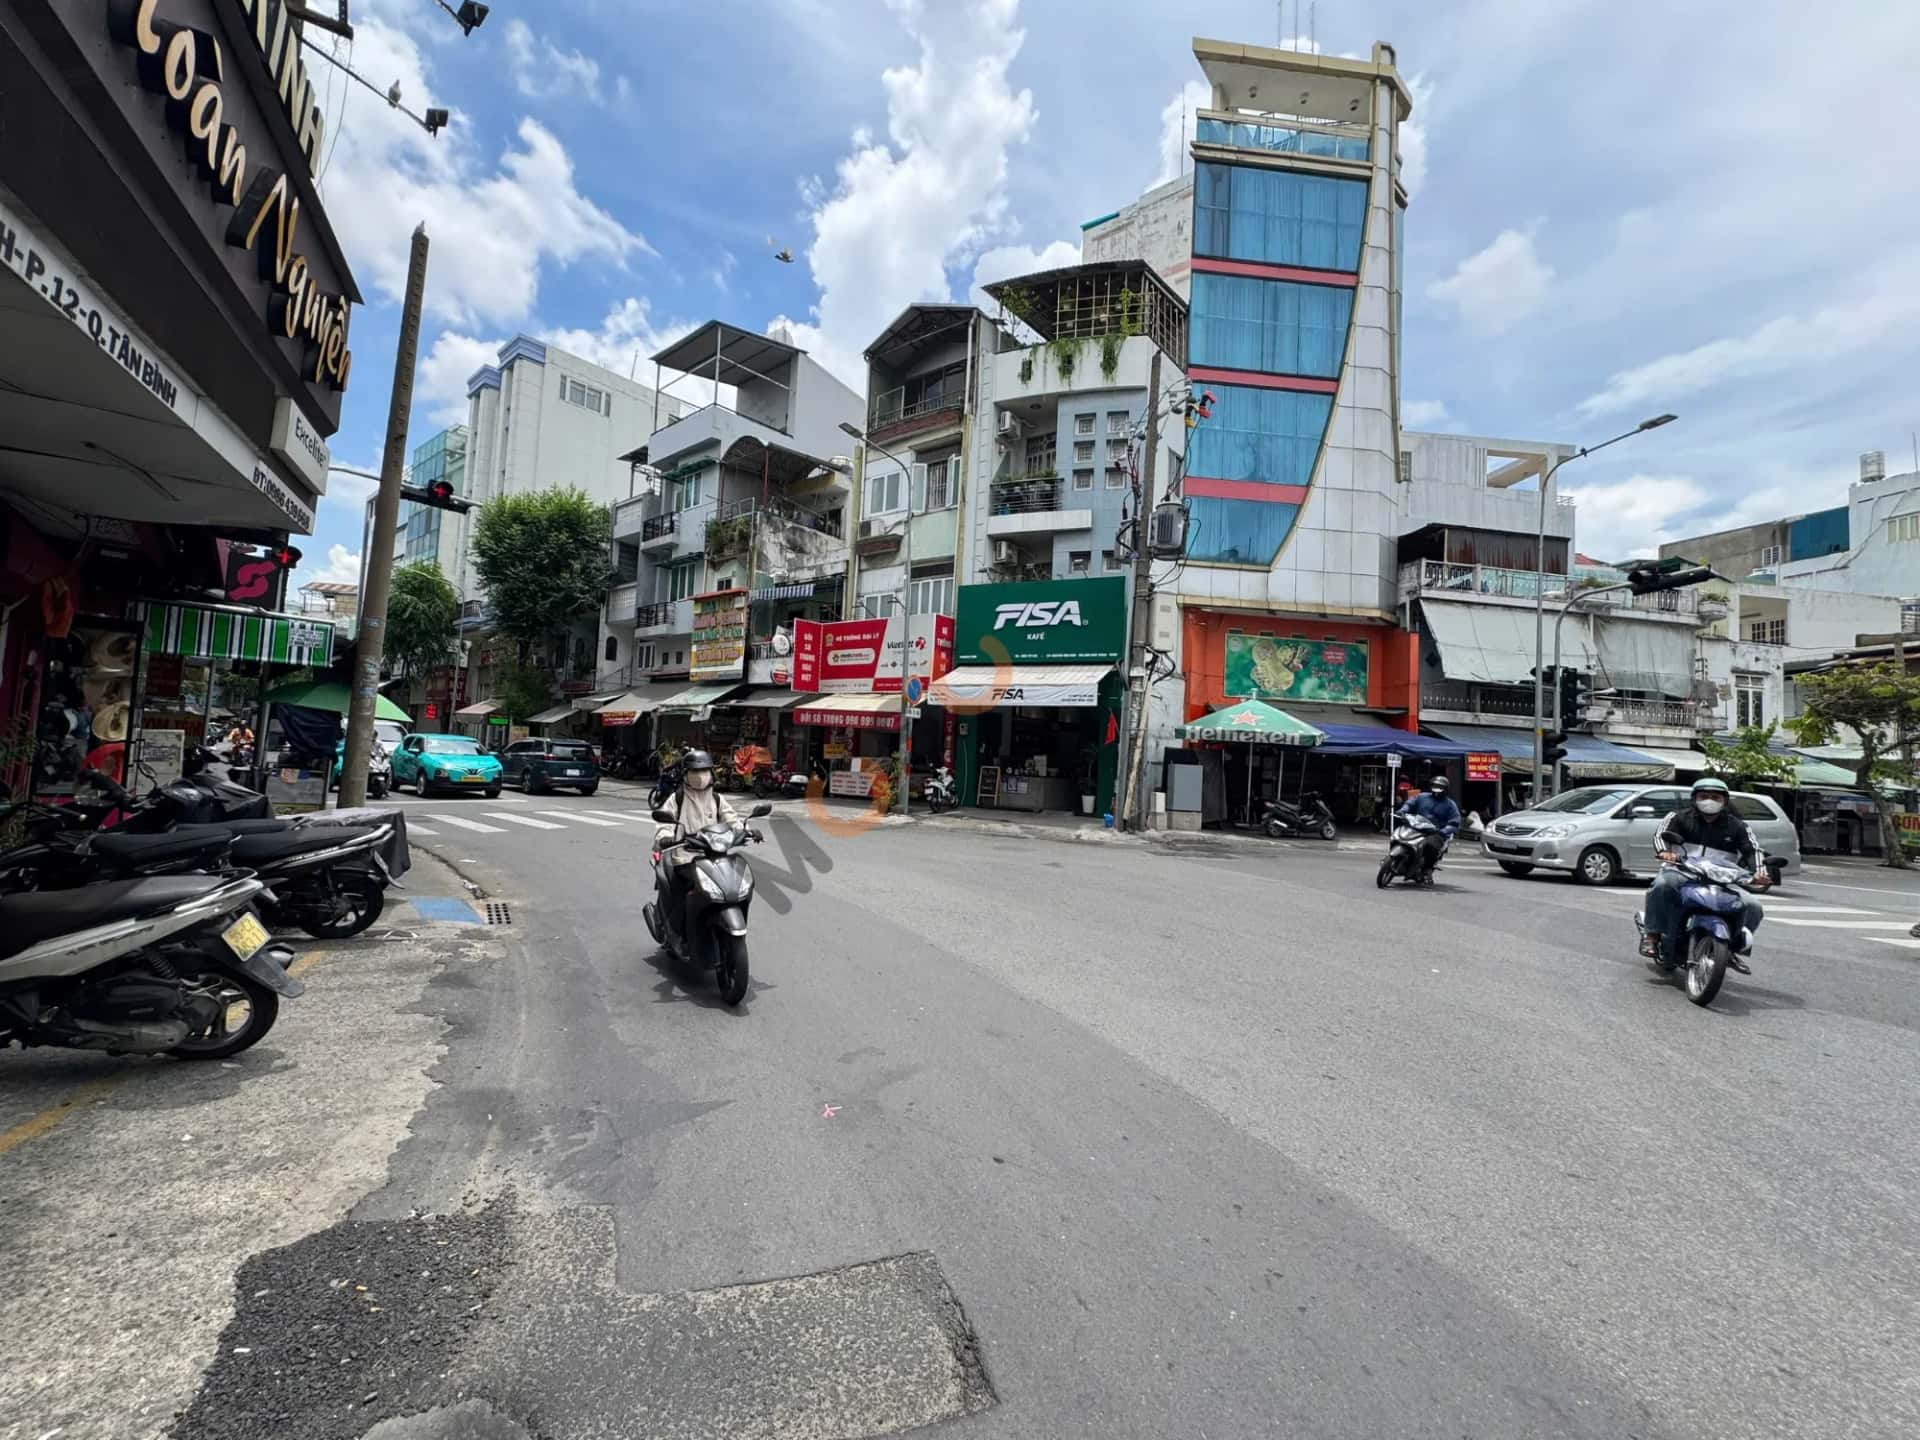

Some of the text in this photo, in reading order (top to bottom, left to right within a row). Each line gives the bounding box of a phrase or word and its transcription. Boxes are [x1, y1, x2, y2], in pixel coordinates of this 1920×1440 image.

[993, 600, 1082, 630] FISA
[1026, 632, 1046, 640] KAFÉ
[992, 688, 1024, 700] FISA
[1186, 726, 1299, 745] Heineken
